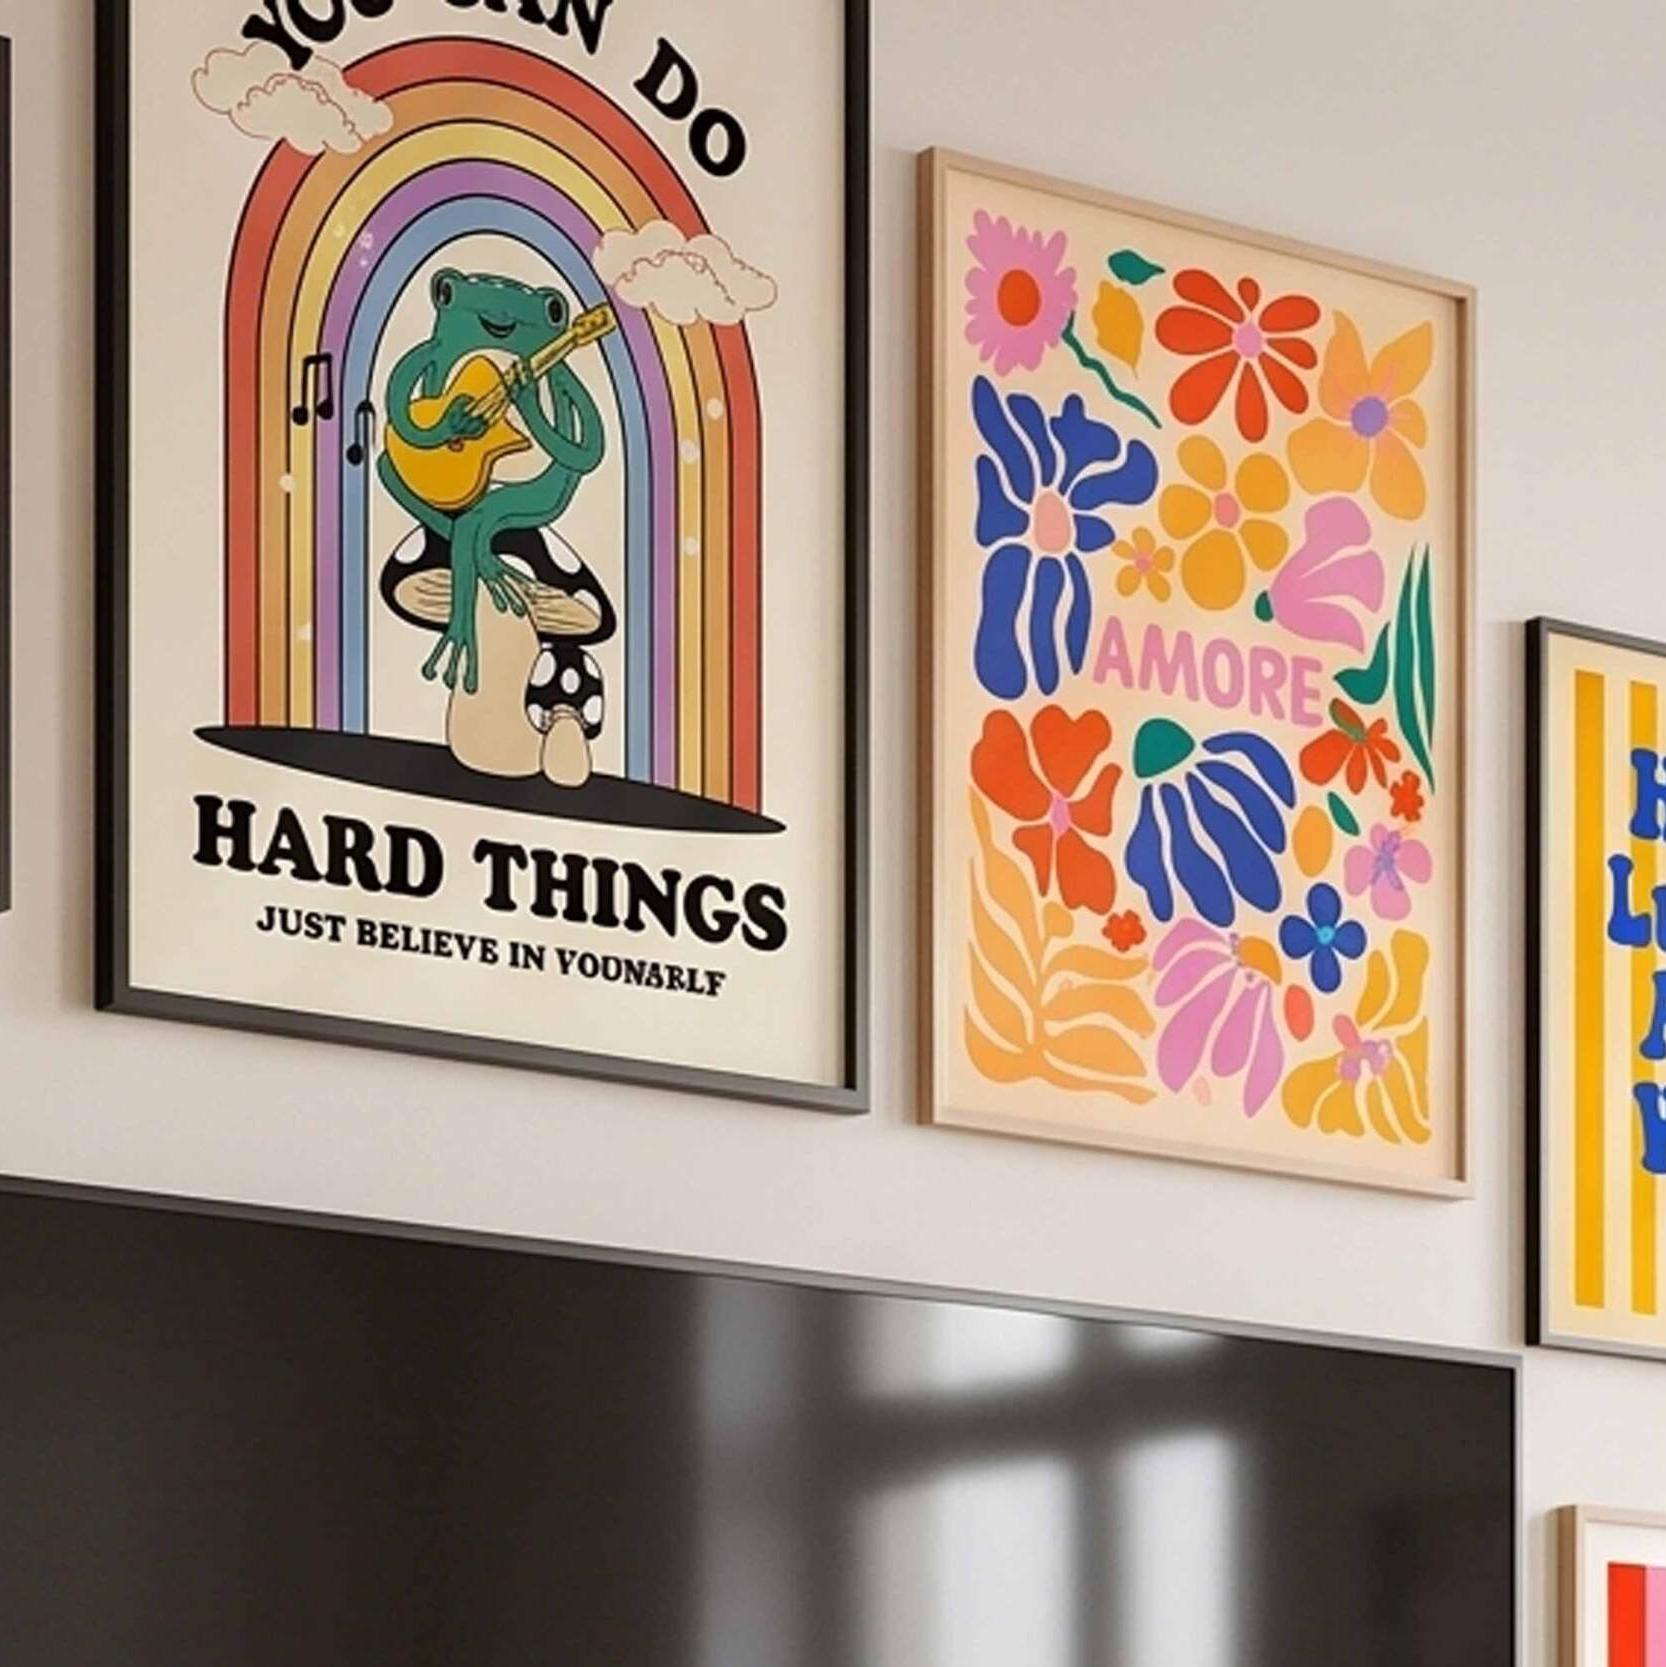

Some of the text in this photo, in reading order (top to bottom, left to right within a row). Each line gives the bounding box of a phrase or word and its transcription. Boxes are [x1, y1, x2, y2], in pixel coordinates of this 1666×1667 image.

[634, 37, 746, 177] DO
[1093, 617, 1323, 728] AMORE
[192, 795, 787, 951] HARD THINGS
[257, 906, 345, 942] JUST
[357, 918, 499, 965] BELIEVE
[509, 941, 546, 971] IN
